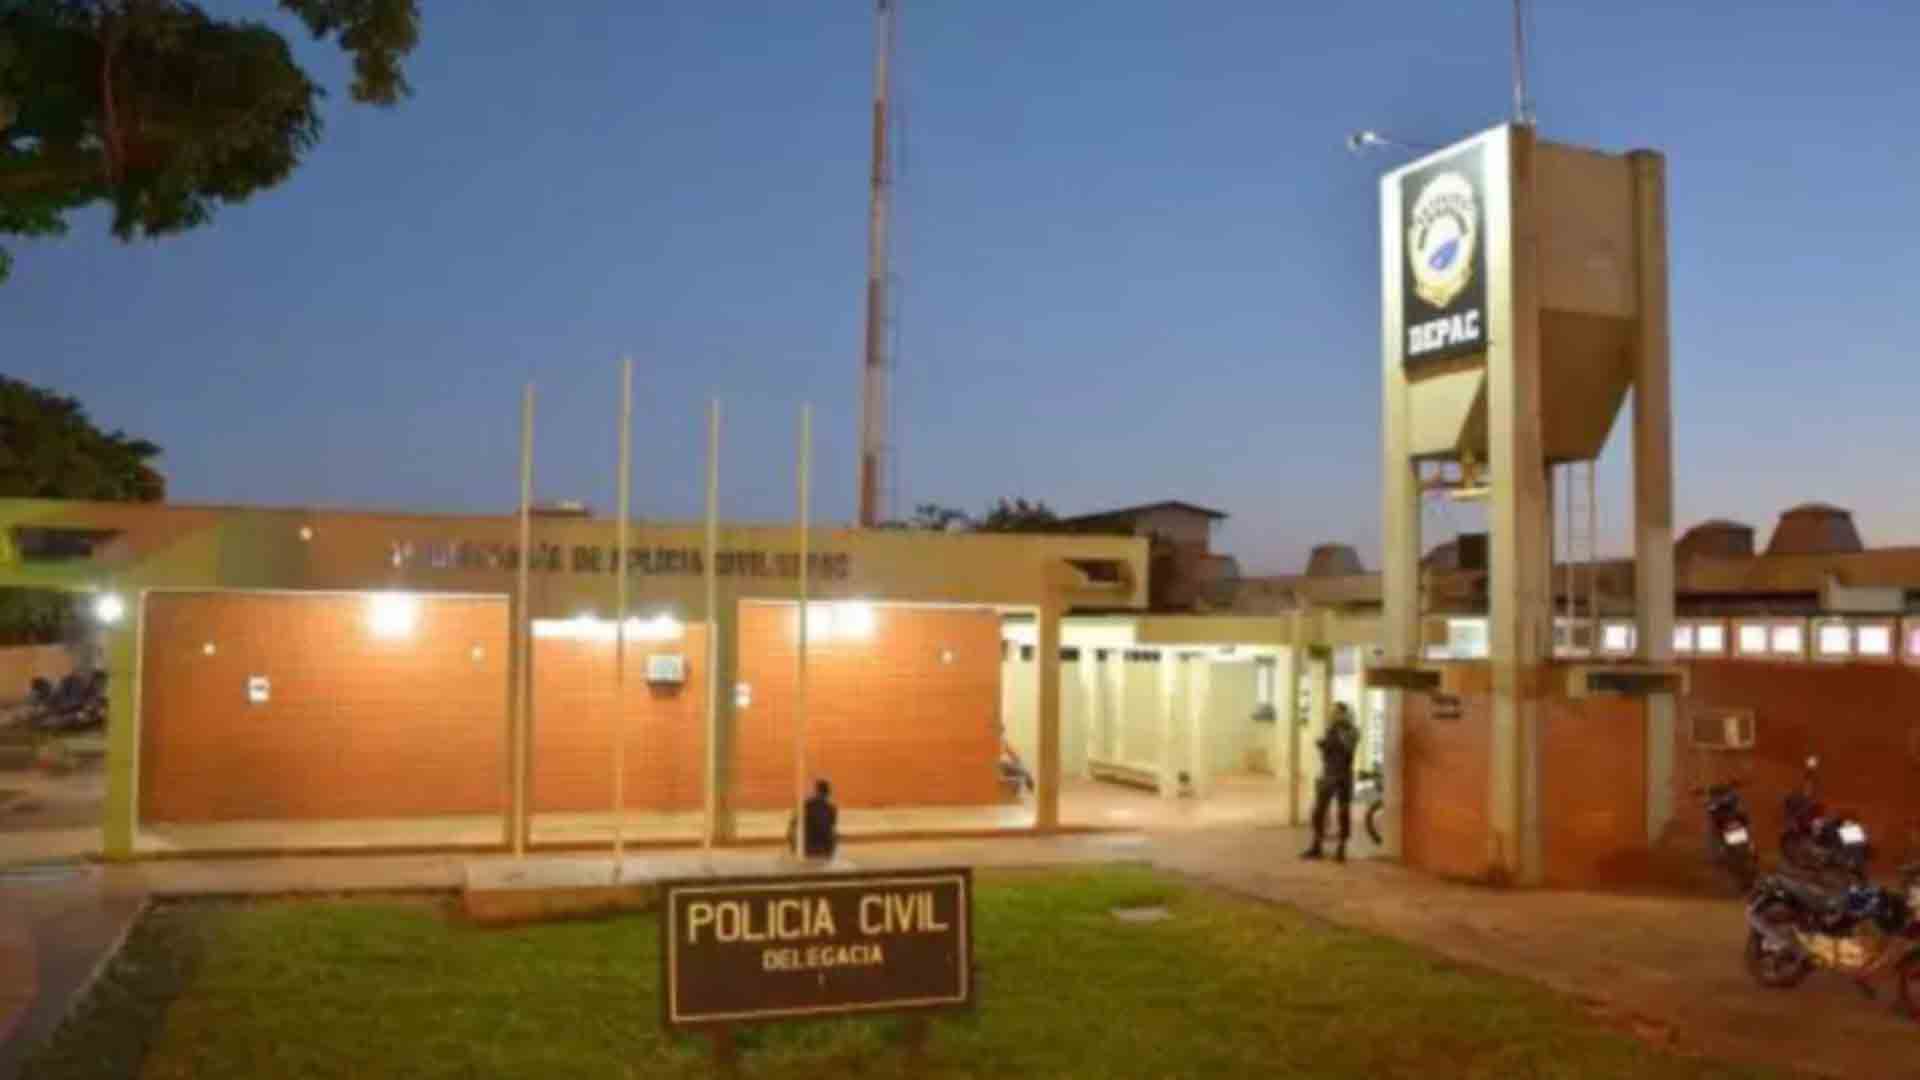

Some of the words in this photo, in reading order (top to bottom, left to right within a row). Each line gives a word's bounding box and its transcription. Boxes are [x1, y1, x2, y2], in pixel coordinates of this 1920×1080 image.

[1408, 310, 1480, 355] DEPAC
[687, 900, 836, 943] POLICIA
[859, 892, 949, 935] CIVIL
[762, 945, 883, 971] DELEGACIA
